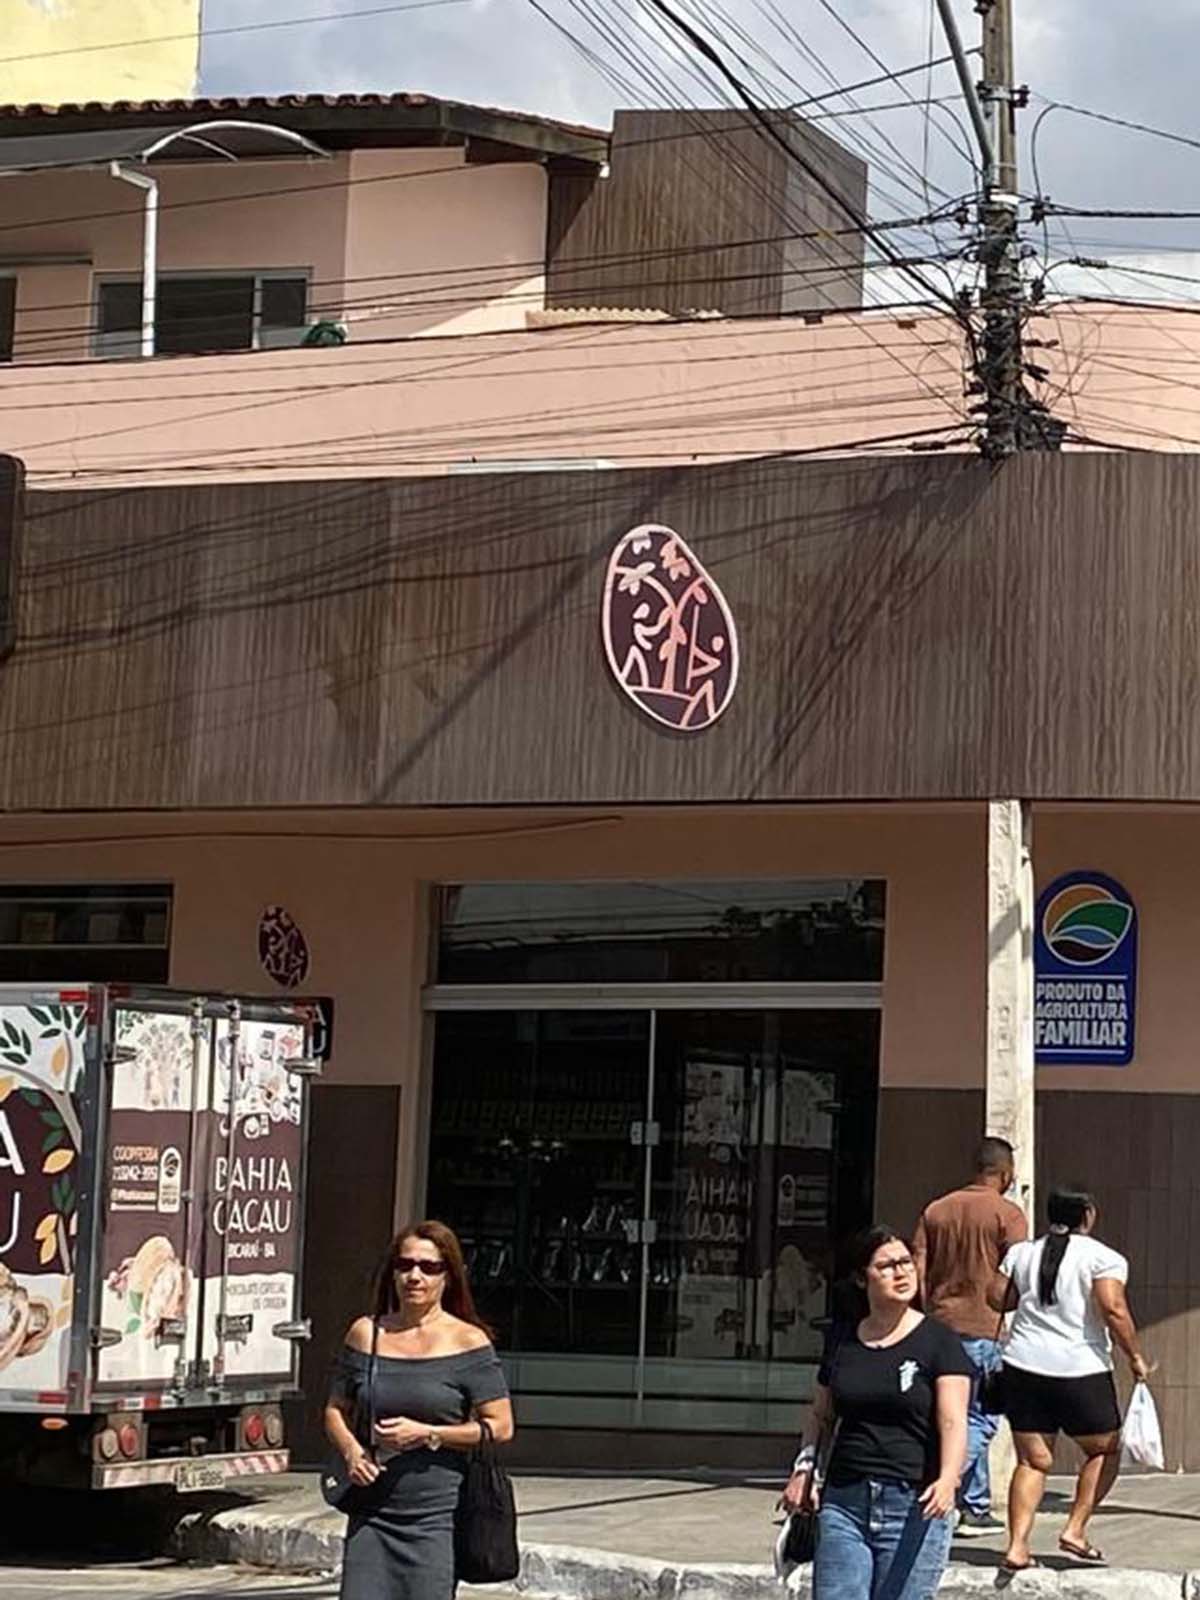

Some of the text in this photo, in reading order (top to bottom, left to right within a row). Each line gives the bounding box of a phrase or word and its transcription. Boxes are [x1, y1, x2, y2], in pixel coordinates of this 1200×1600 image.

[1036, 983, 1126, 1001] PRODUTO DA
[1035, 1002, 1128, 1020] AGRICULTURA
[1035, 1021, 1127, 1046] FAMILIAR
[215, 1157, 292, 1192] BAHIA
[213, 1199, 292, 1234] CACAU
